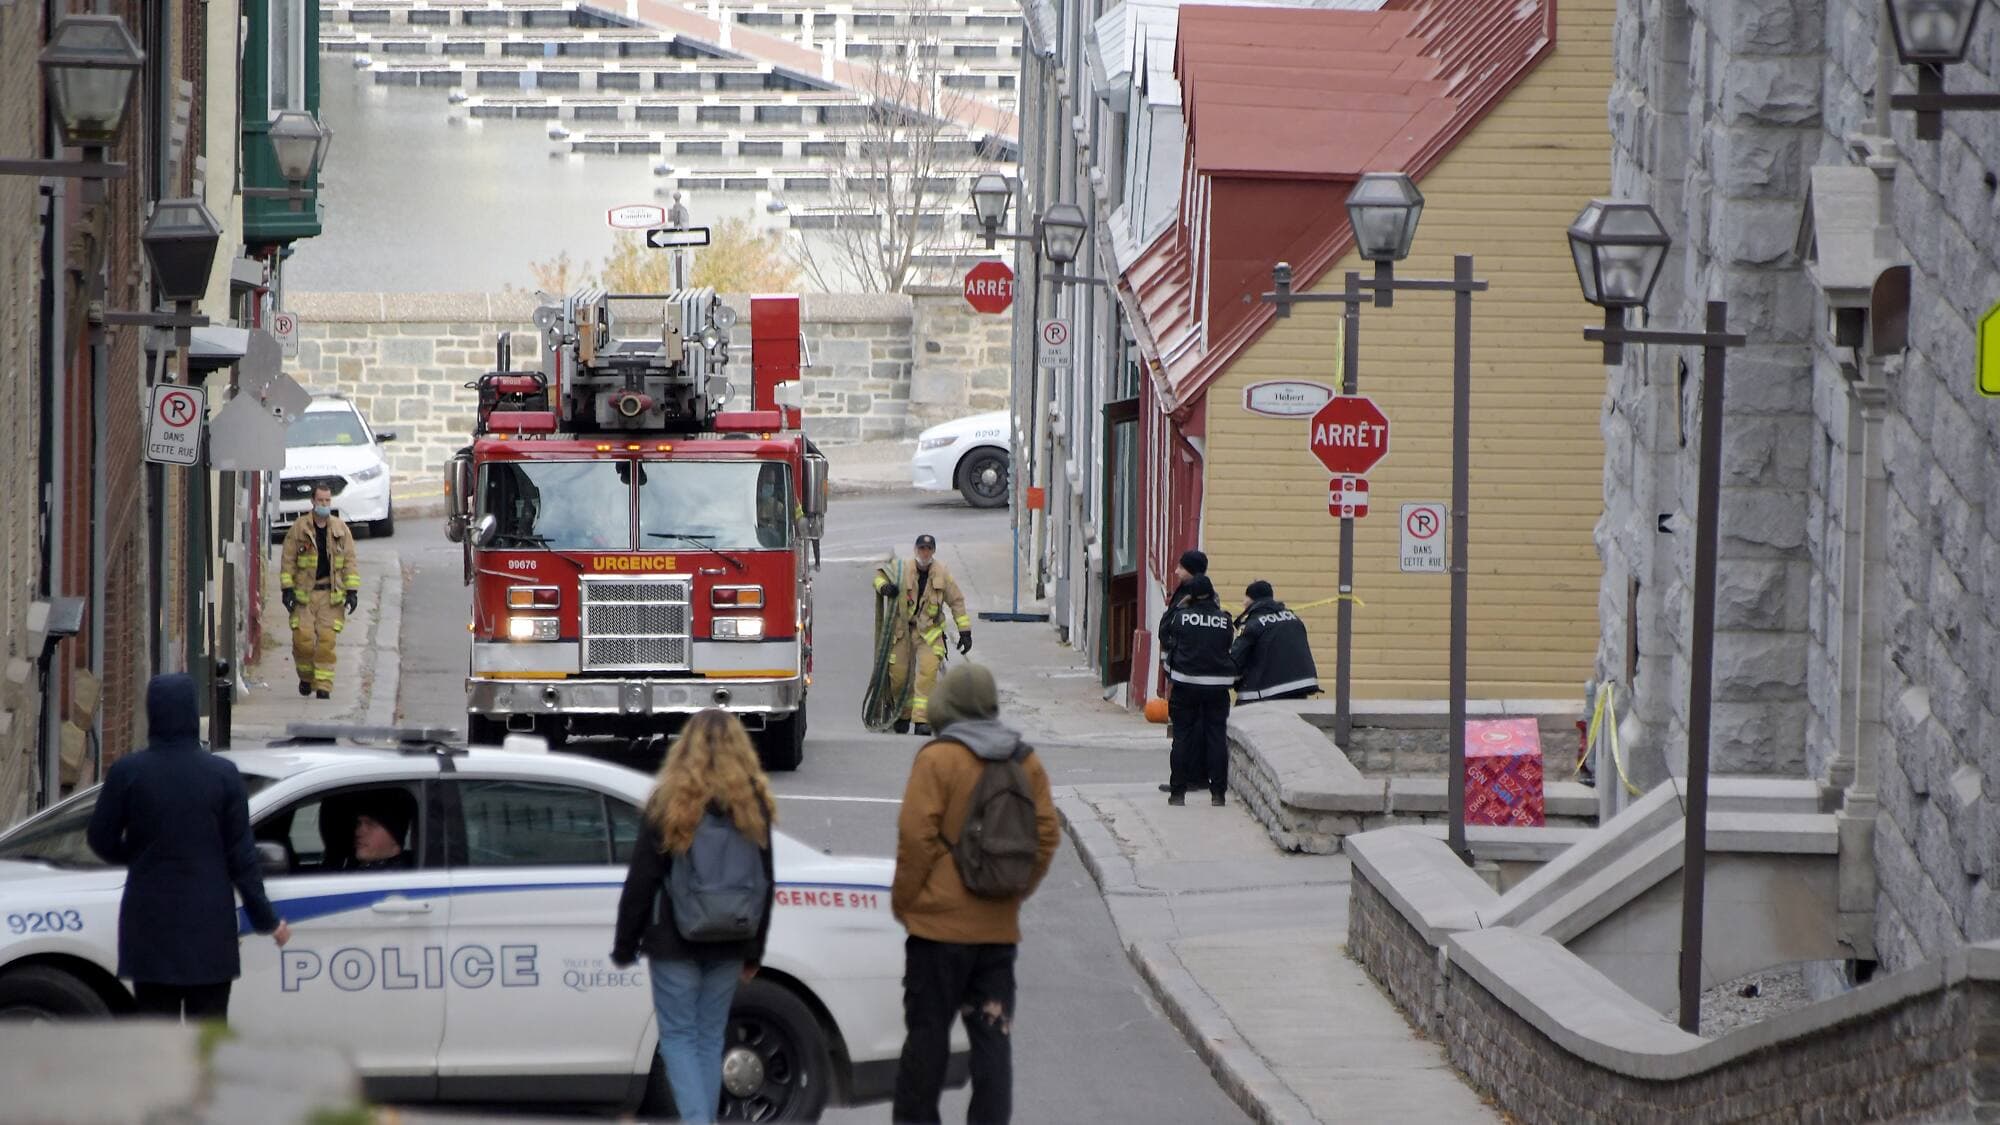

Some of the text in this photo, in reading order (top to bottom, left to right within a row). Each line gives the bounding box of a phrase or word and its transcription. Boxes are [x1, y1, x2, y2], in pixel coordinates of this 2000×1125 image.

[966, 277, 1013, 296] ARRÊT
[163, 431, 185, 442] DANS
[1314, 421, 1386, 448] ARRÊT
[150, 443, 194, 457] CETTE RUE
[1413, 545, 1432, 554] DANS
[593, 556, 677, 570] URGENCE
[1404, 557, 1441, 566] CETTE RUE
[1181, 613, 1228, 629] POLICE
[775, 890, 878, 909] GENCE 911
[7, 909, 84, 935] 9203
[281, 944, 540, 993] POLICE
[563, 968, 644, 992] QUÉBEC
